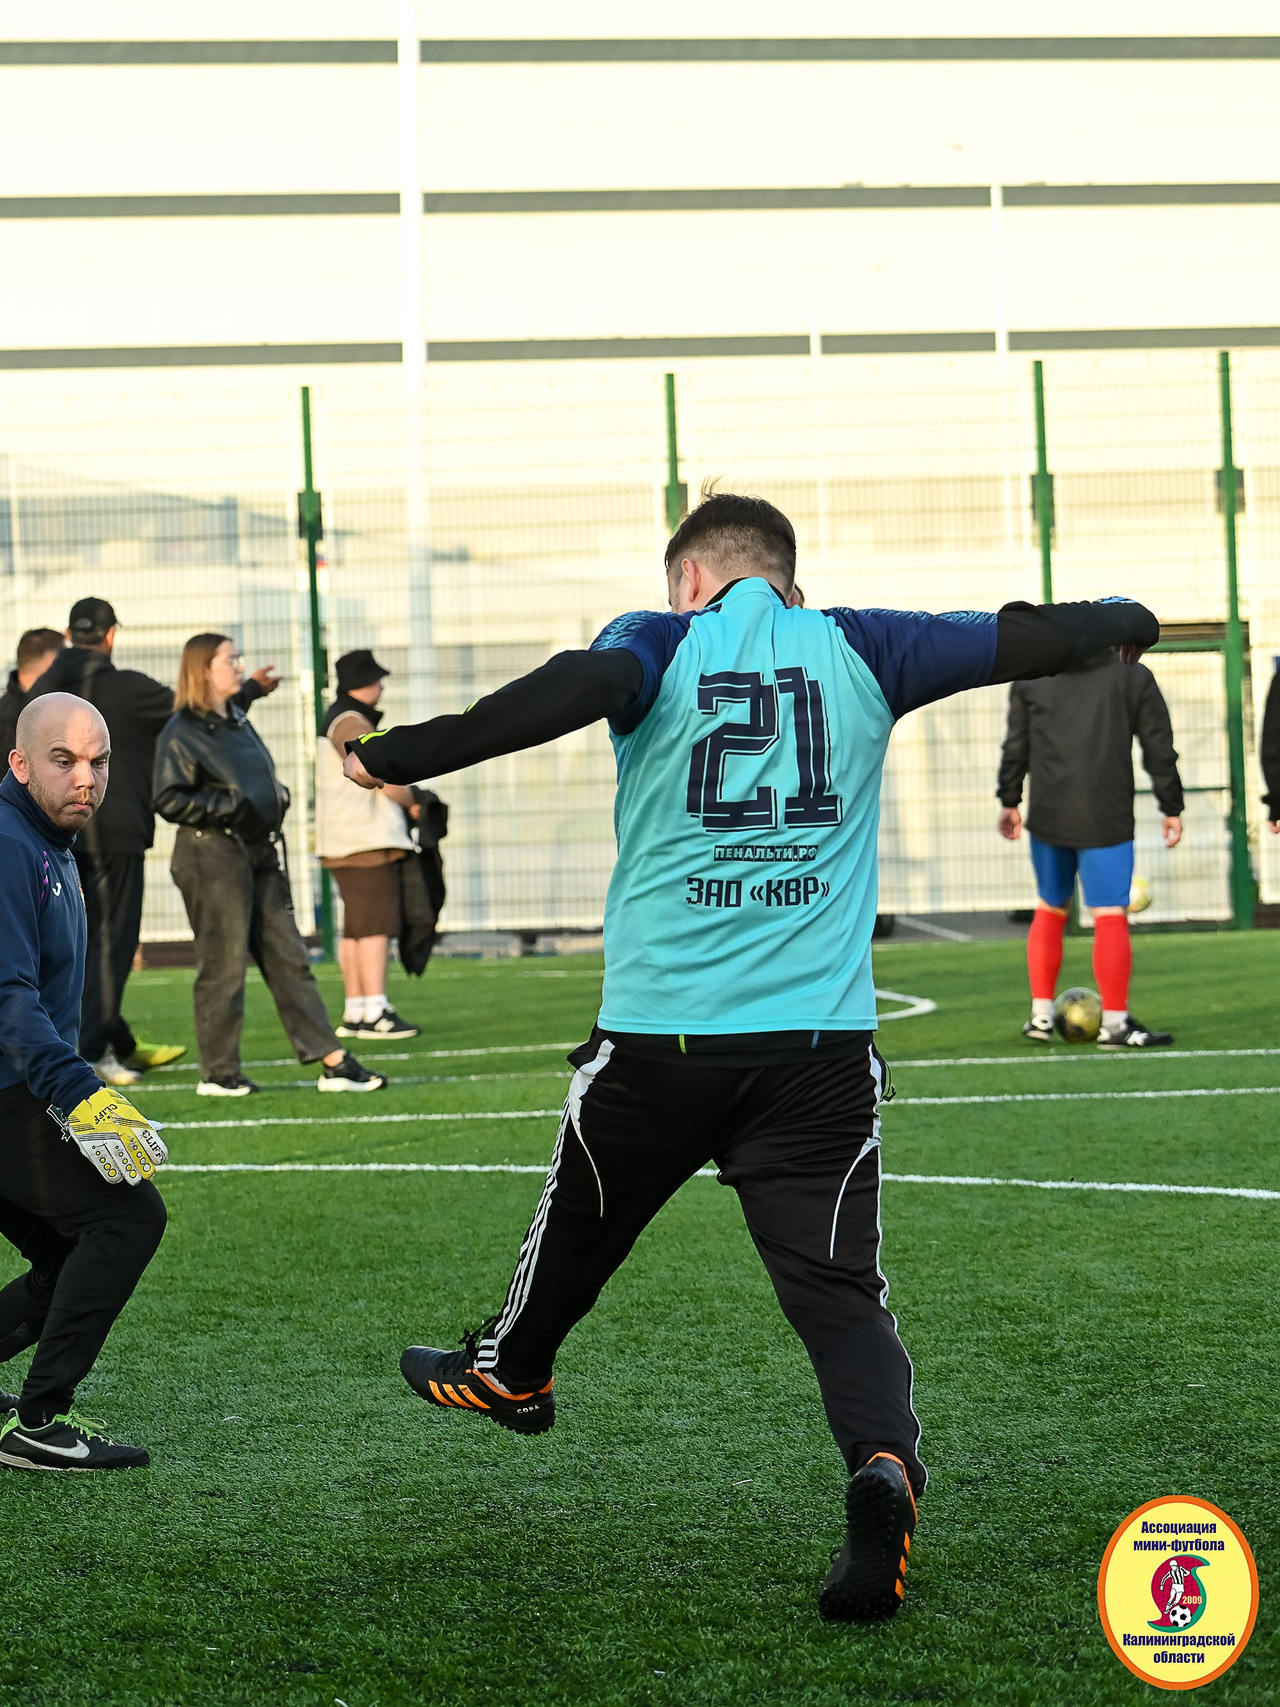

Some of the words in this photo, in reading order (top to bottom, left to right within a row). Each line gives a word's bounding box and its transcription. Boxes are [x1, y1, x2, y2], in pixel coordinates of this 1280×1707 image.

[686, 666, 843, 832] 21
[714, 844, 819, 861] ПЕНАЛЬТИ.РФ
[685, 876, 743, 908] ЗАО
[749, 875, 830, 907] «КВР»
[94, 1103, 118, 1125] CLIFF
[516, 1404, 540, 1414] COPA
